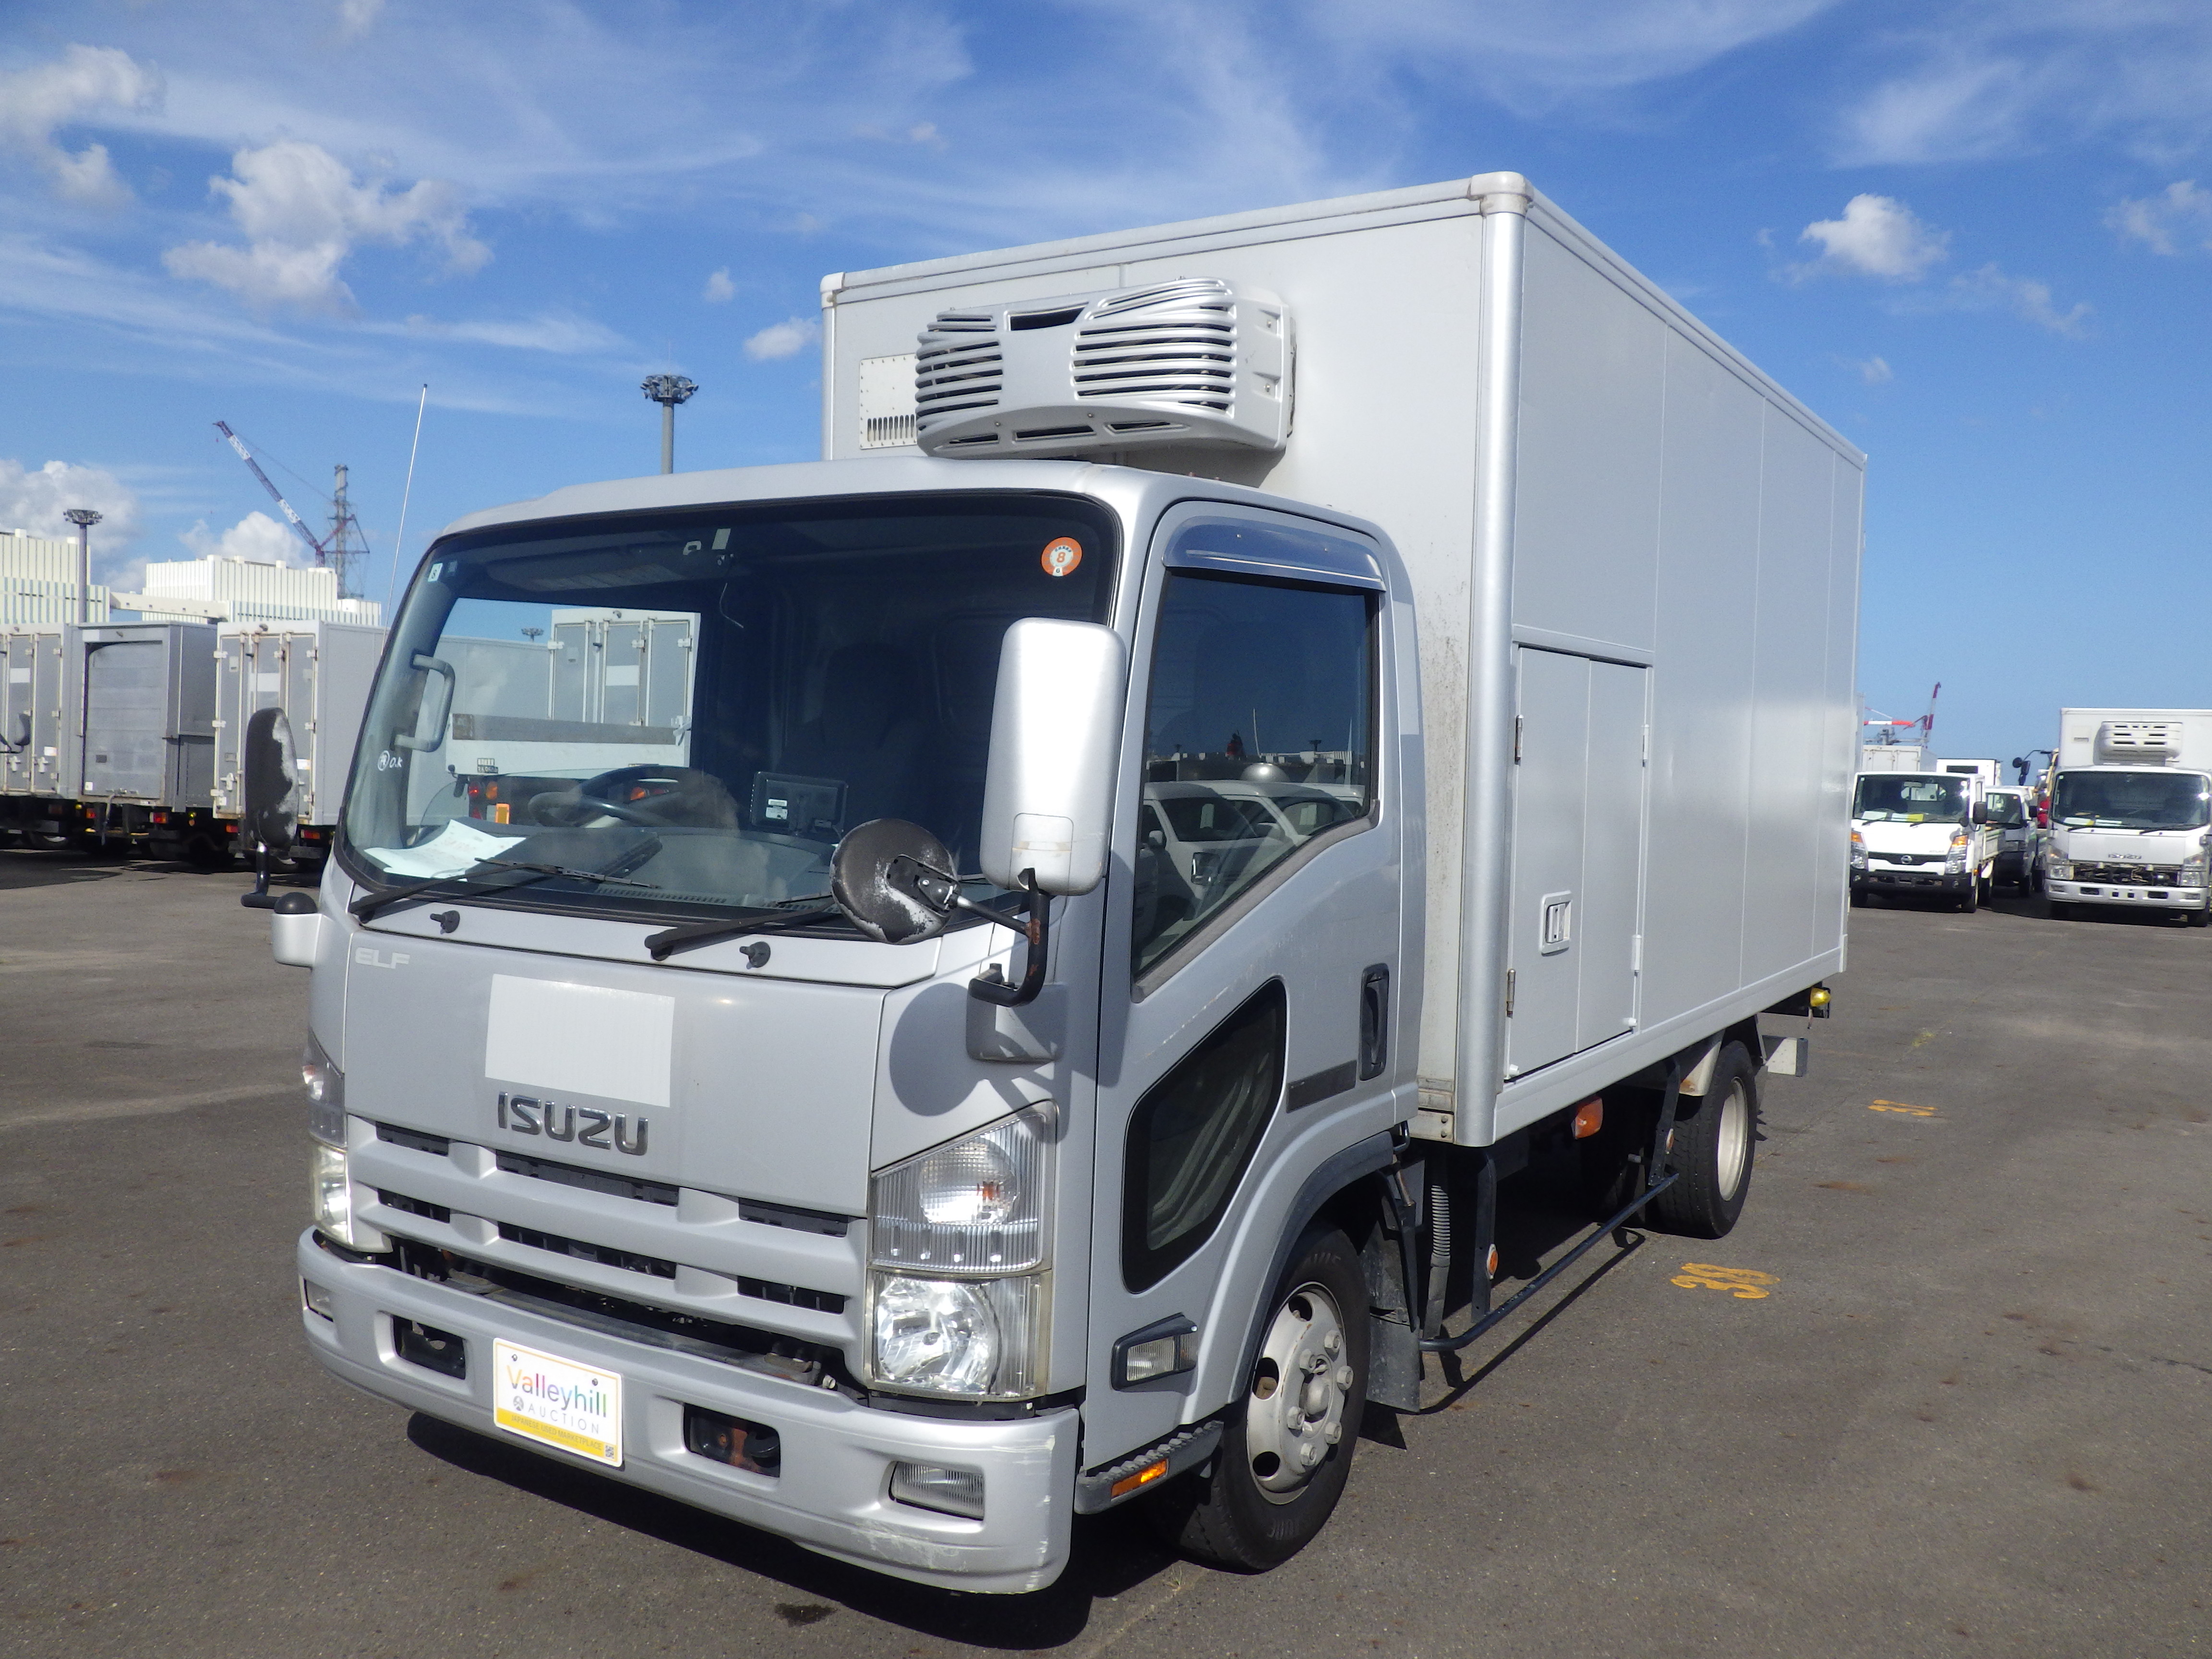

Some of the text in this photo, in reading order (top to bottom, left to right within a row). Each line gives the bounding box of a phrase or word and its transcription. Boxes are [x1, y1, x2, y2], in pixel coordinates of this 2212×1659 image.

[1057, 552, 1066, 563] 8
[355, 947, 410, 969] ELF
[497, 1091, 649, 1156] ISUZU
[507, 1365, 607, 1418] Valleyhill
[511, 1415, 540, 1431] JAPANESE
[541, 1423, 557, 1435] USED
[558, 1430, 602, 1451] MARKETPLACE
[528, 1403, 599, 1434] AUCTION
